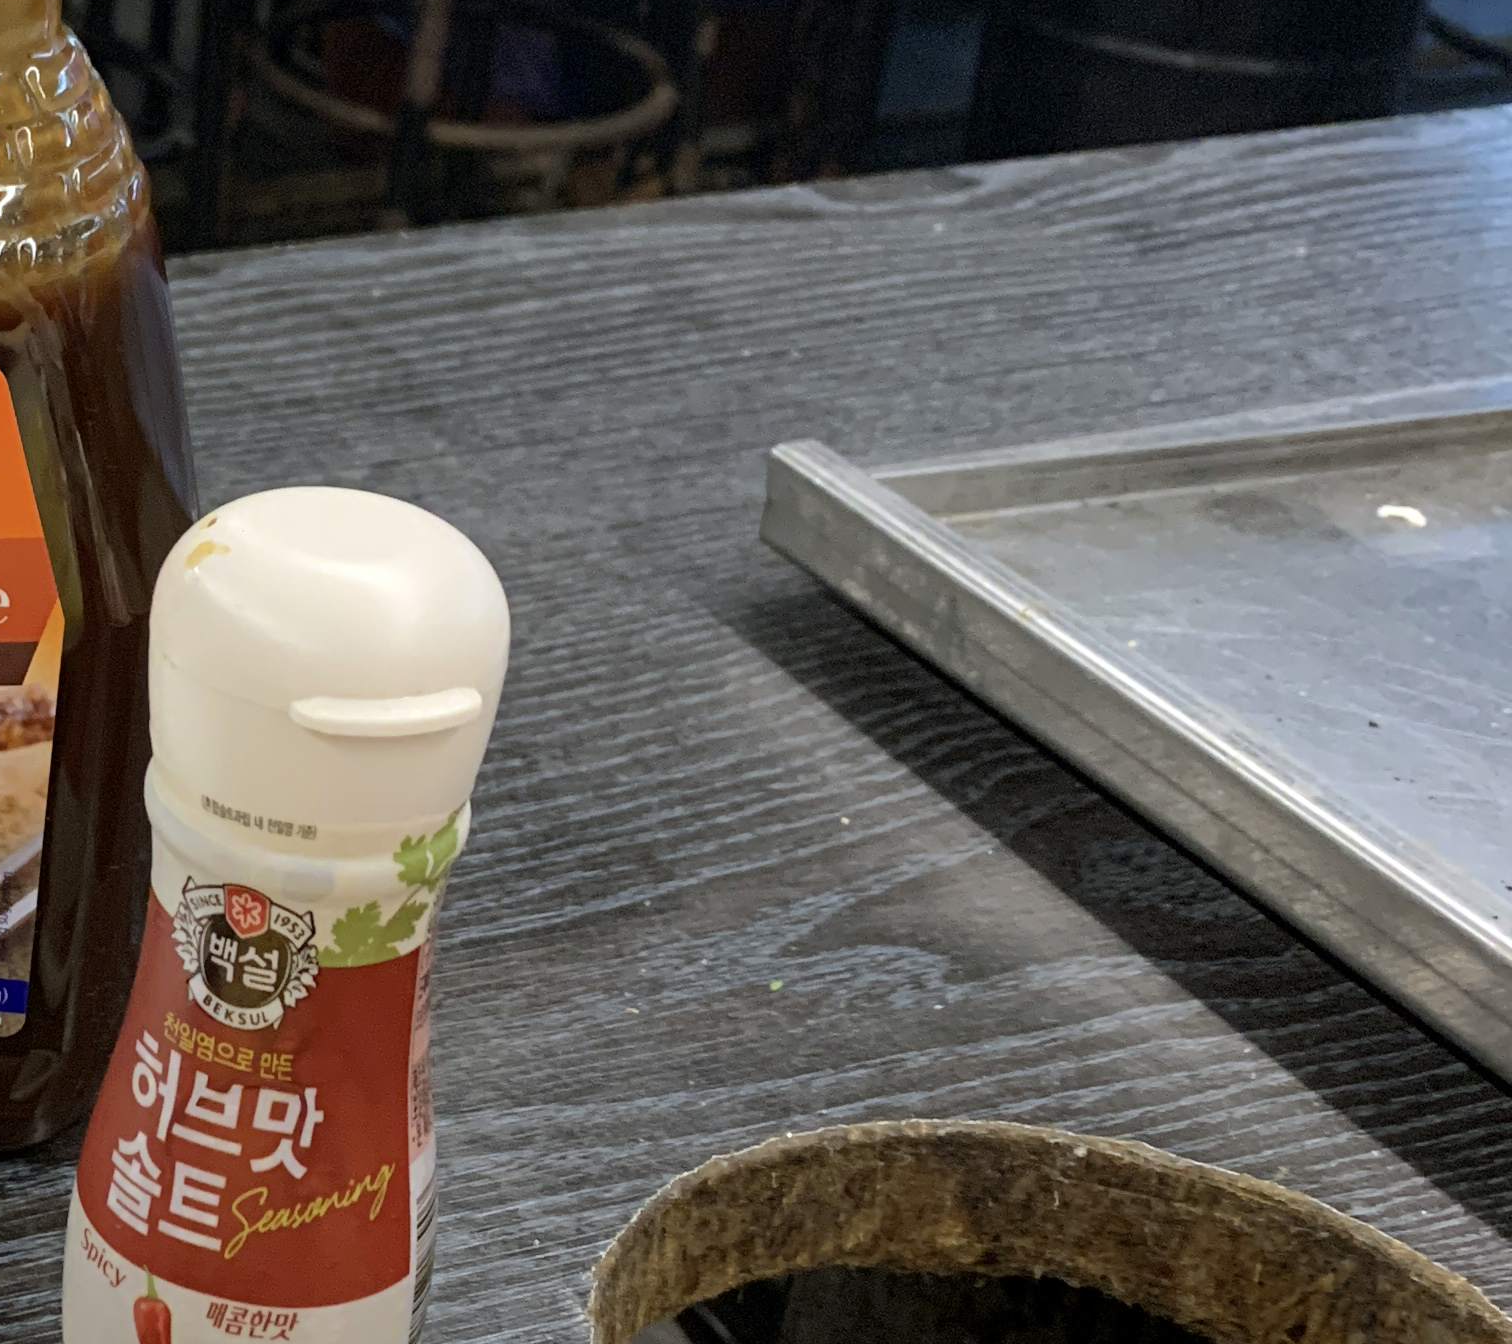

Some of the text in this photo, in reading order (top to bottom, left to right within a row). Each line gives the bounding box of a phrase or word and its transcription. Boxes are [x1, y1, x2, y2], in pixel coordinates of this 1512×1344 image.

[189, 893, 306, 941] SINCE 1953
[208, 931, 280, 993] 백설
[202, 994, 270, 1026] BEKSUL
[163, 1010, 294, 1082] 천일염으로 만든
[131, 1030, 325, 1180] 허브맛
[105, 1128, 229, 1252] 솔트
[223, 1162, 397, 1260] Seasoning
[79, 1226, 128, 1289] Spicy
[206, 1300, 300, 1342] 매콤한맛
